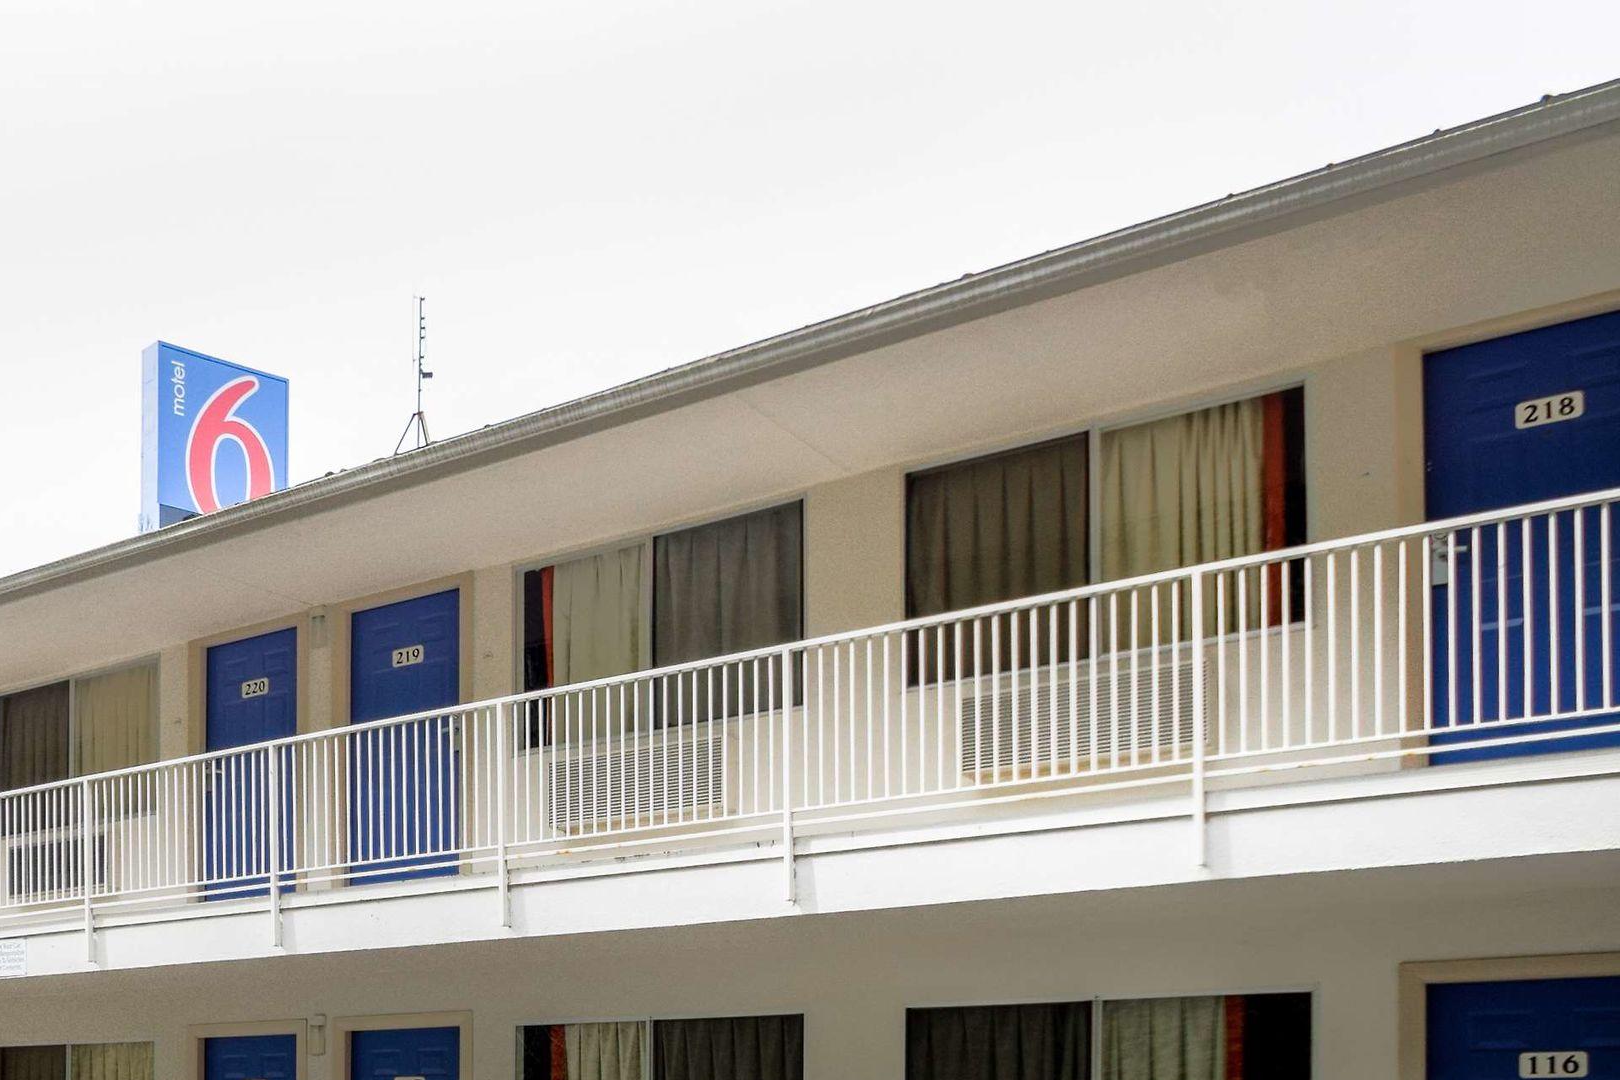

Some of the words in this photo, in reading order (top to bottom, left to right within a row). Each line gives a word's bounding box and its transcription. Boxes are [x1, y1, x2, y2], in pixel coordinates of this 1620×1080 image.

[171, 360, 186, 416] motel
[1523, 397, 1575, 424] 218
[185, 375, 276, 515] 6
[396, 648, 420, 665] 219
[244, 680, 266, 696] 220
[1528, 1054, 1579, 1075] 116
